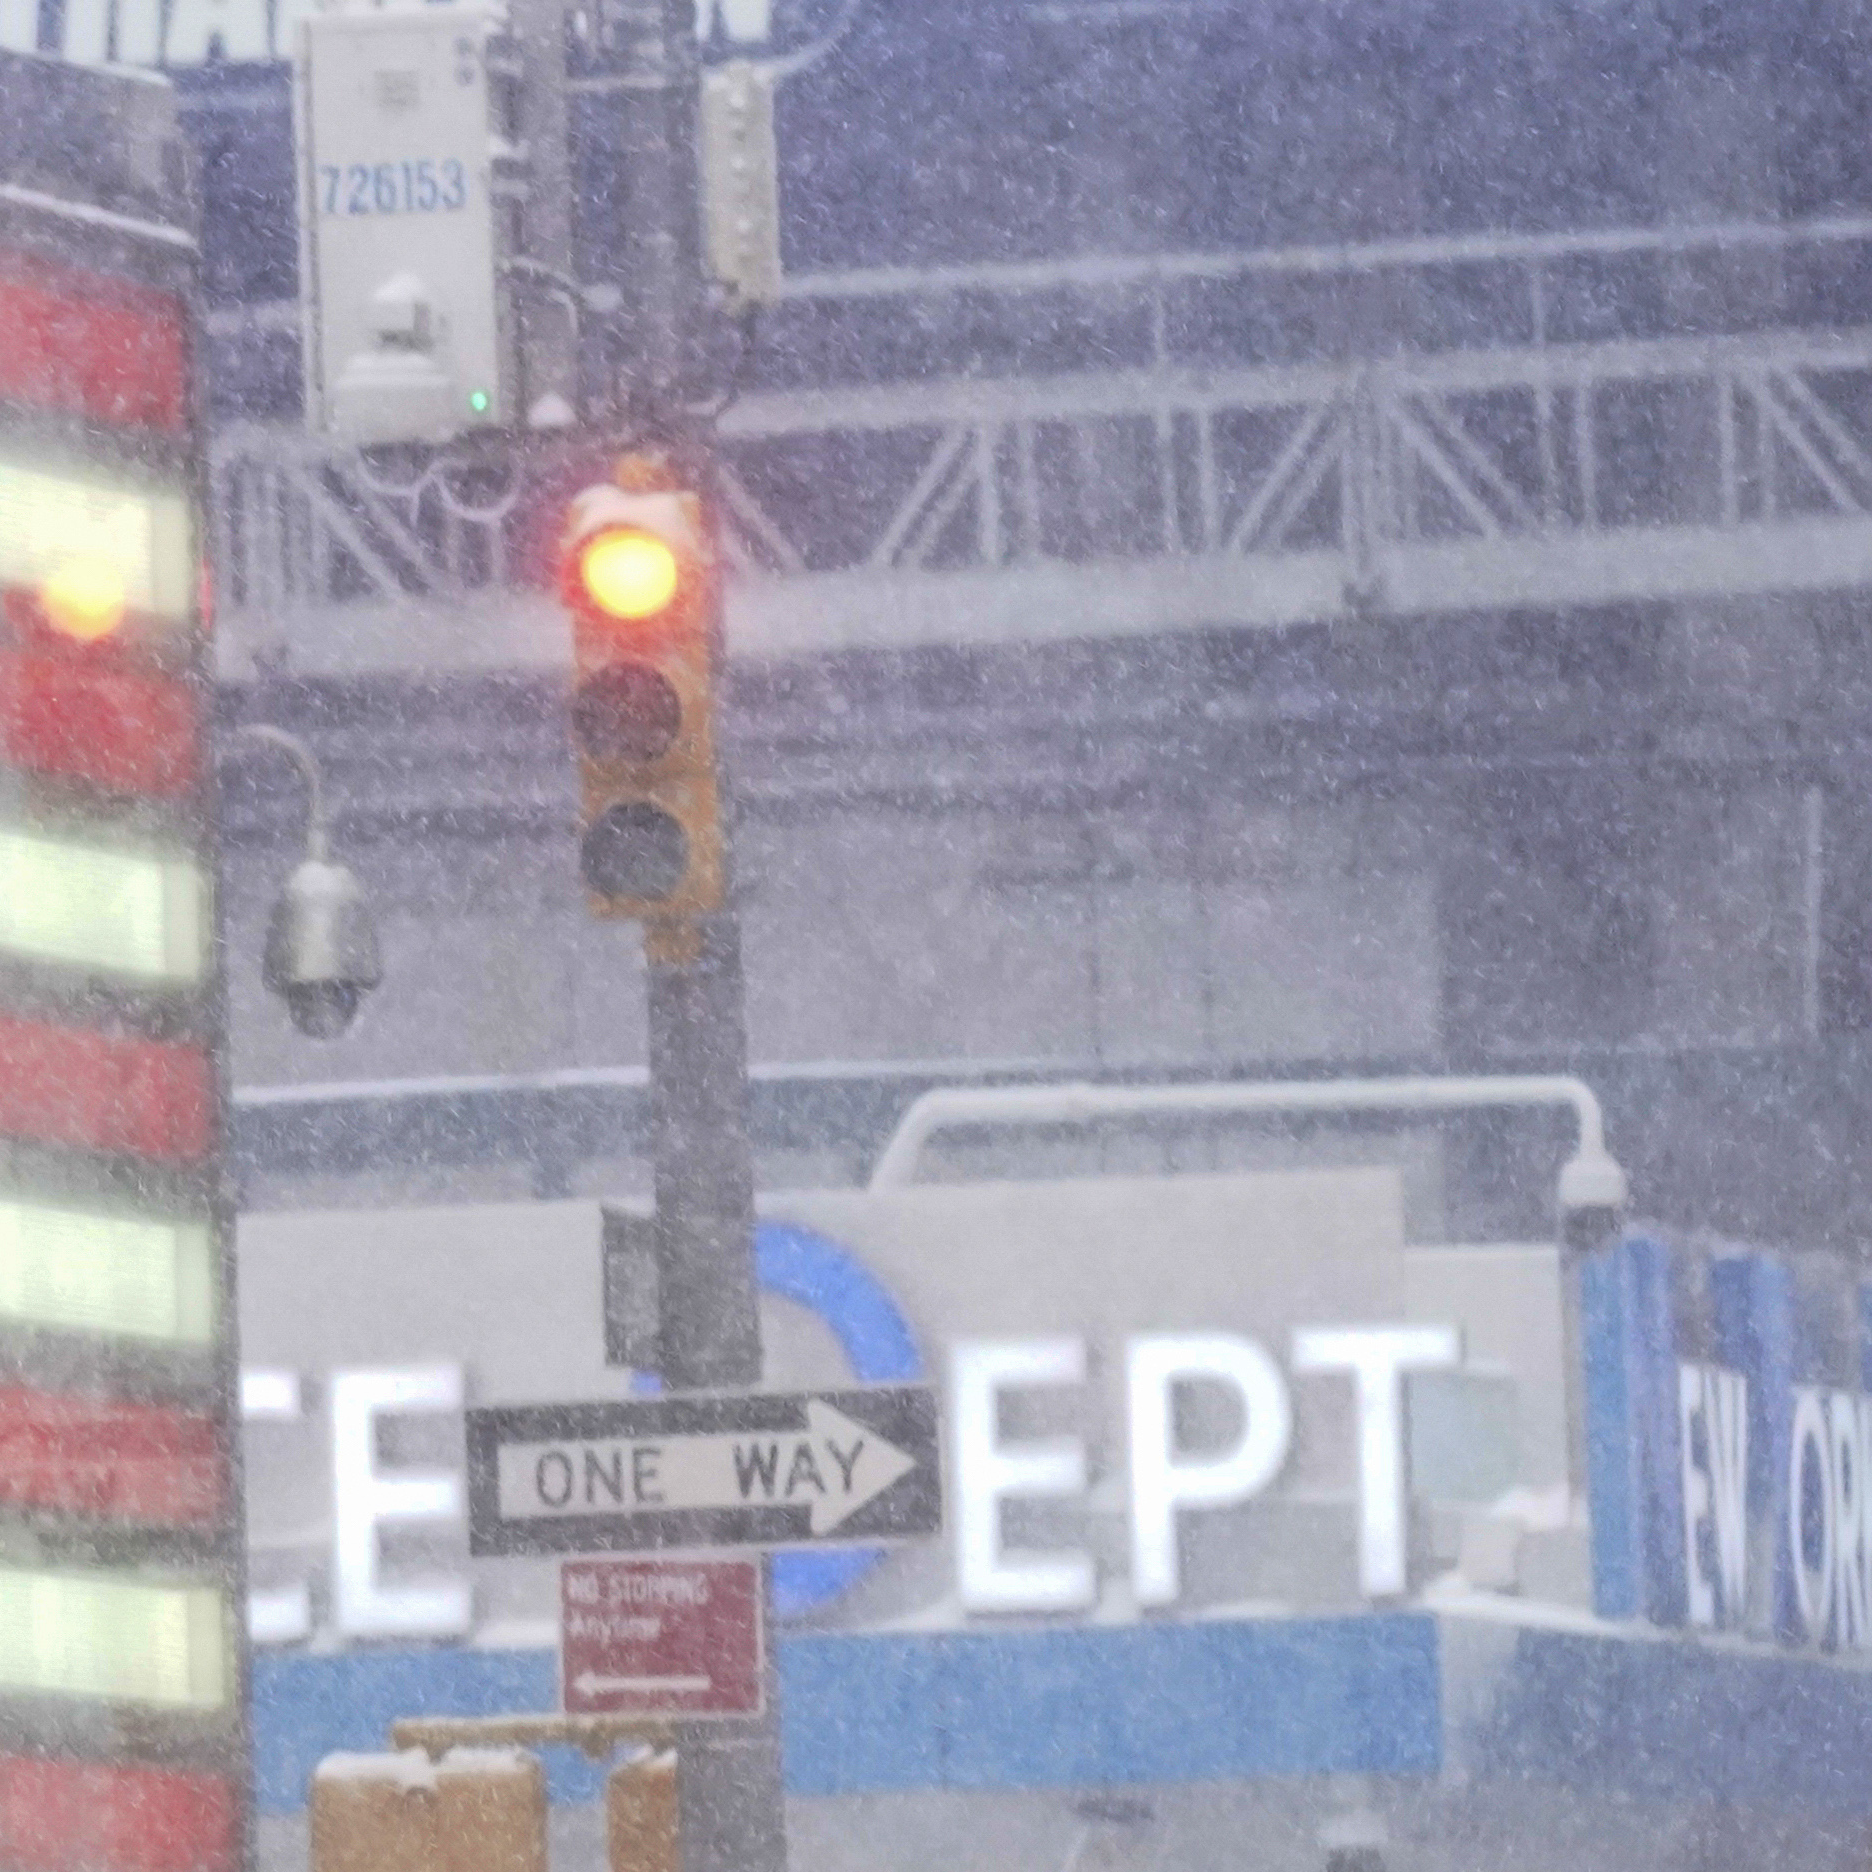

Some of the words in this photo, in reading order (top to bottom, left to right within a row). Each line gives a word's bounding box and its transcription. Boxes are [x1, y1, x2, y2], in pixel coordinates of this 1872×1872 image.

[317, 158, 467, 216] 726153
[535, 1446, 666, 1508] ONE
[732, 1438, 865, 1499] WAY
